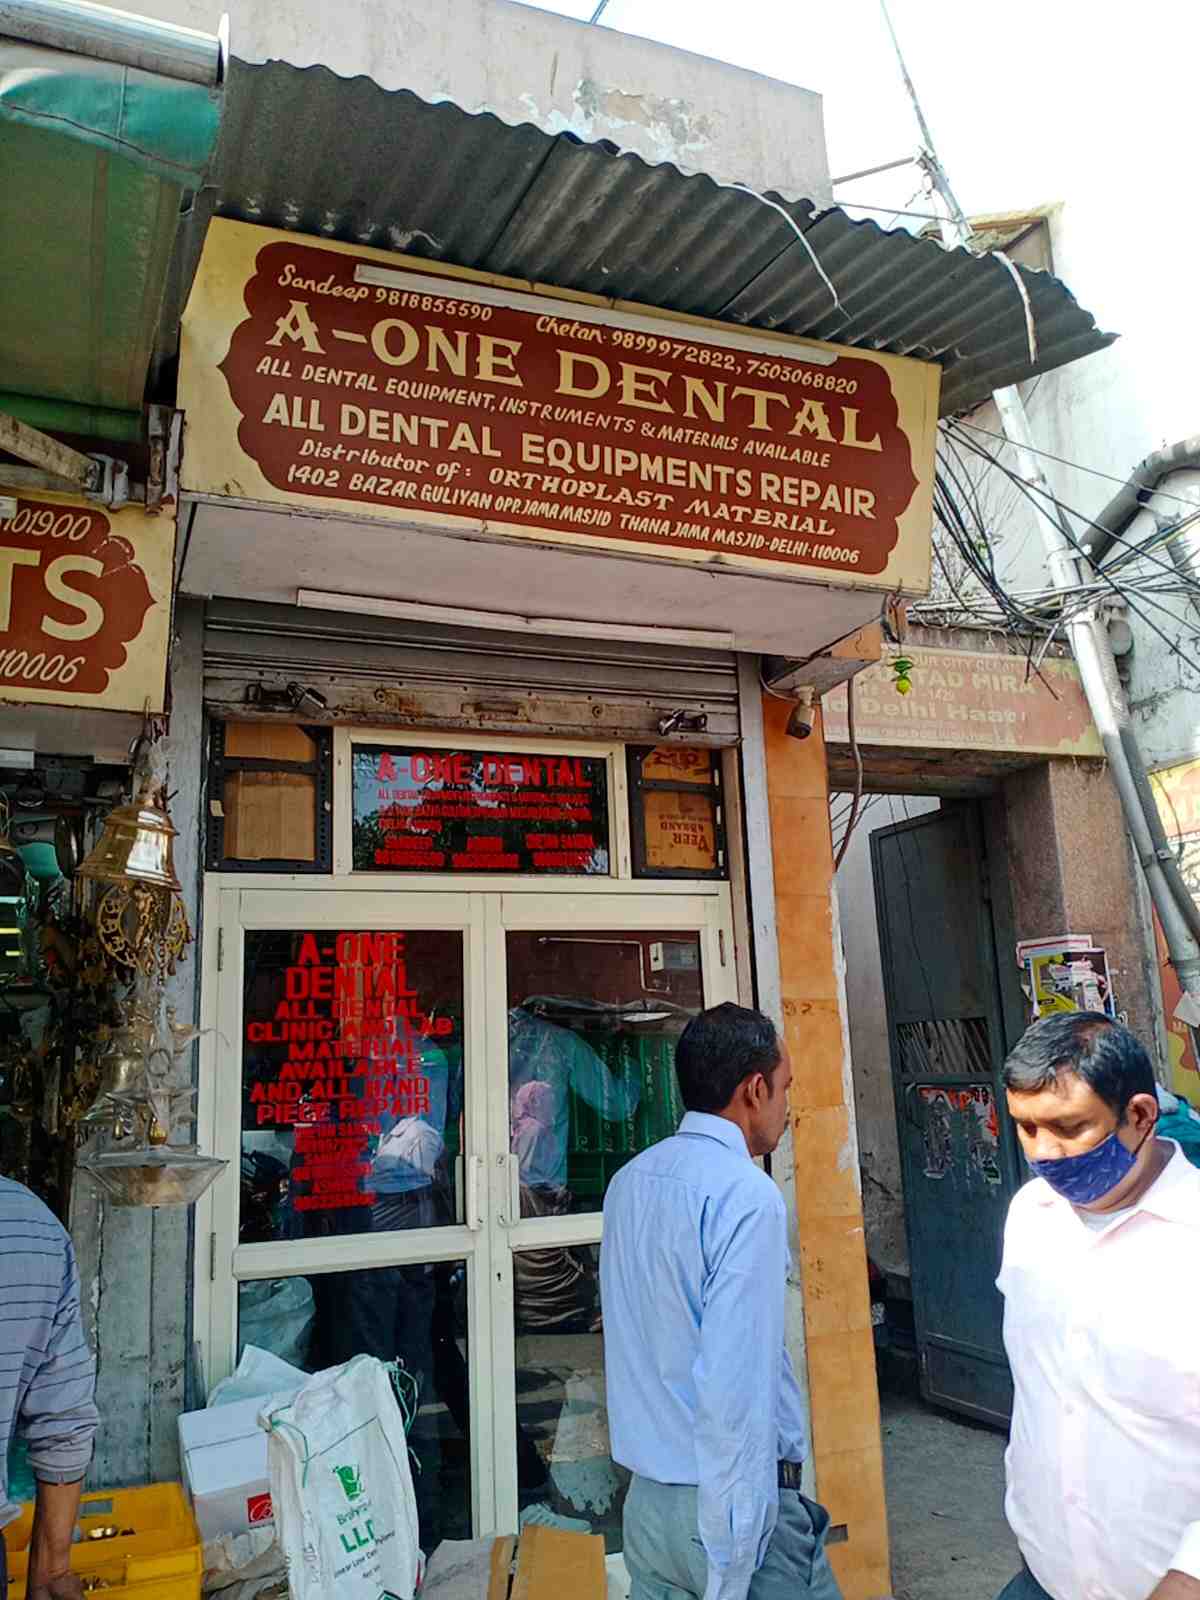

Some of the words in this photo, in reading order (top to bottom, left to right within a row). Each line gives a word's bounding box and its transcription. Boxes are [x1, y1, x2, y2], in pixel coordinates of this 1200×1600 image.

[278, 264, 369, 303] Sandeep
[376, 288, 492, 321] 9818855590
[266, 299, 524, 387] A-ONE
[555, 349, 883, 452] DENTAL
[256, 356, 291, 379] ALL
[302, 365, 377, 392] DENTAL
[657, 424, 739, 451] MATERIALS
[744, 440, 830, 468] AVAILABLE
[263, 393, 325, 431] ALL
[341, 405, 502, 457] DENTAL
[522, 433, 752, 498] EQUIPMENTS
[760, 473, 876, 519] REPAIR
[288, 463, 339, 488] 1402
[350, 475, 416, 499] BAZAR
[421, 487, 491, 510] GULIYAN
[560, 505, 611, 528] MASJID
[621, 514, 669, 536] THANA
[670, 521, 709, 543] JAMA
[300, 439, 430, 473] Distributor
[489, 467, 674, 512] ORTHOPLAST
[685, 499, 836, 536] MATERIAL
[861, 697, 937, 719] Delhi
[375, 752, 471, 783] A-ONE
[483, 754, 591, 787] DENTAL
[299, 932, 405, 964] A-ONE
[286, 966, 417, 1000] DENTAL
[275, 1001, 321, 1018] ALL
[332, 1000, 423, 1017] DENTAL
[248, 1020, 332, 1041] CLINIC
[342, 1018, 395, 1038] AND
[403, 1016, 453, 1037] LAB
[289, 1039, 420, 1060] MATERIAL
[280, 1058, 422, 1079] AVAILABLE
[250, 1081, 306, 1102] AND
[310, 1079, 355, 1099] ALL
[364, 1077, 429, 1098] HAND
[257, 1103, 330, 1124] PIECE
[340, 1100, 430, 1120] REPAIR
